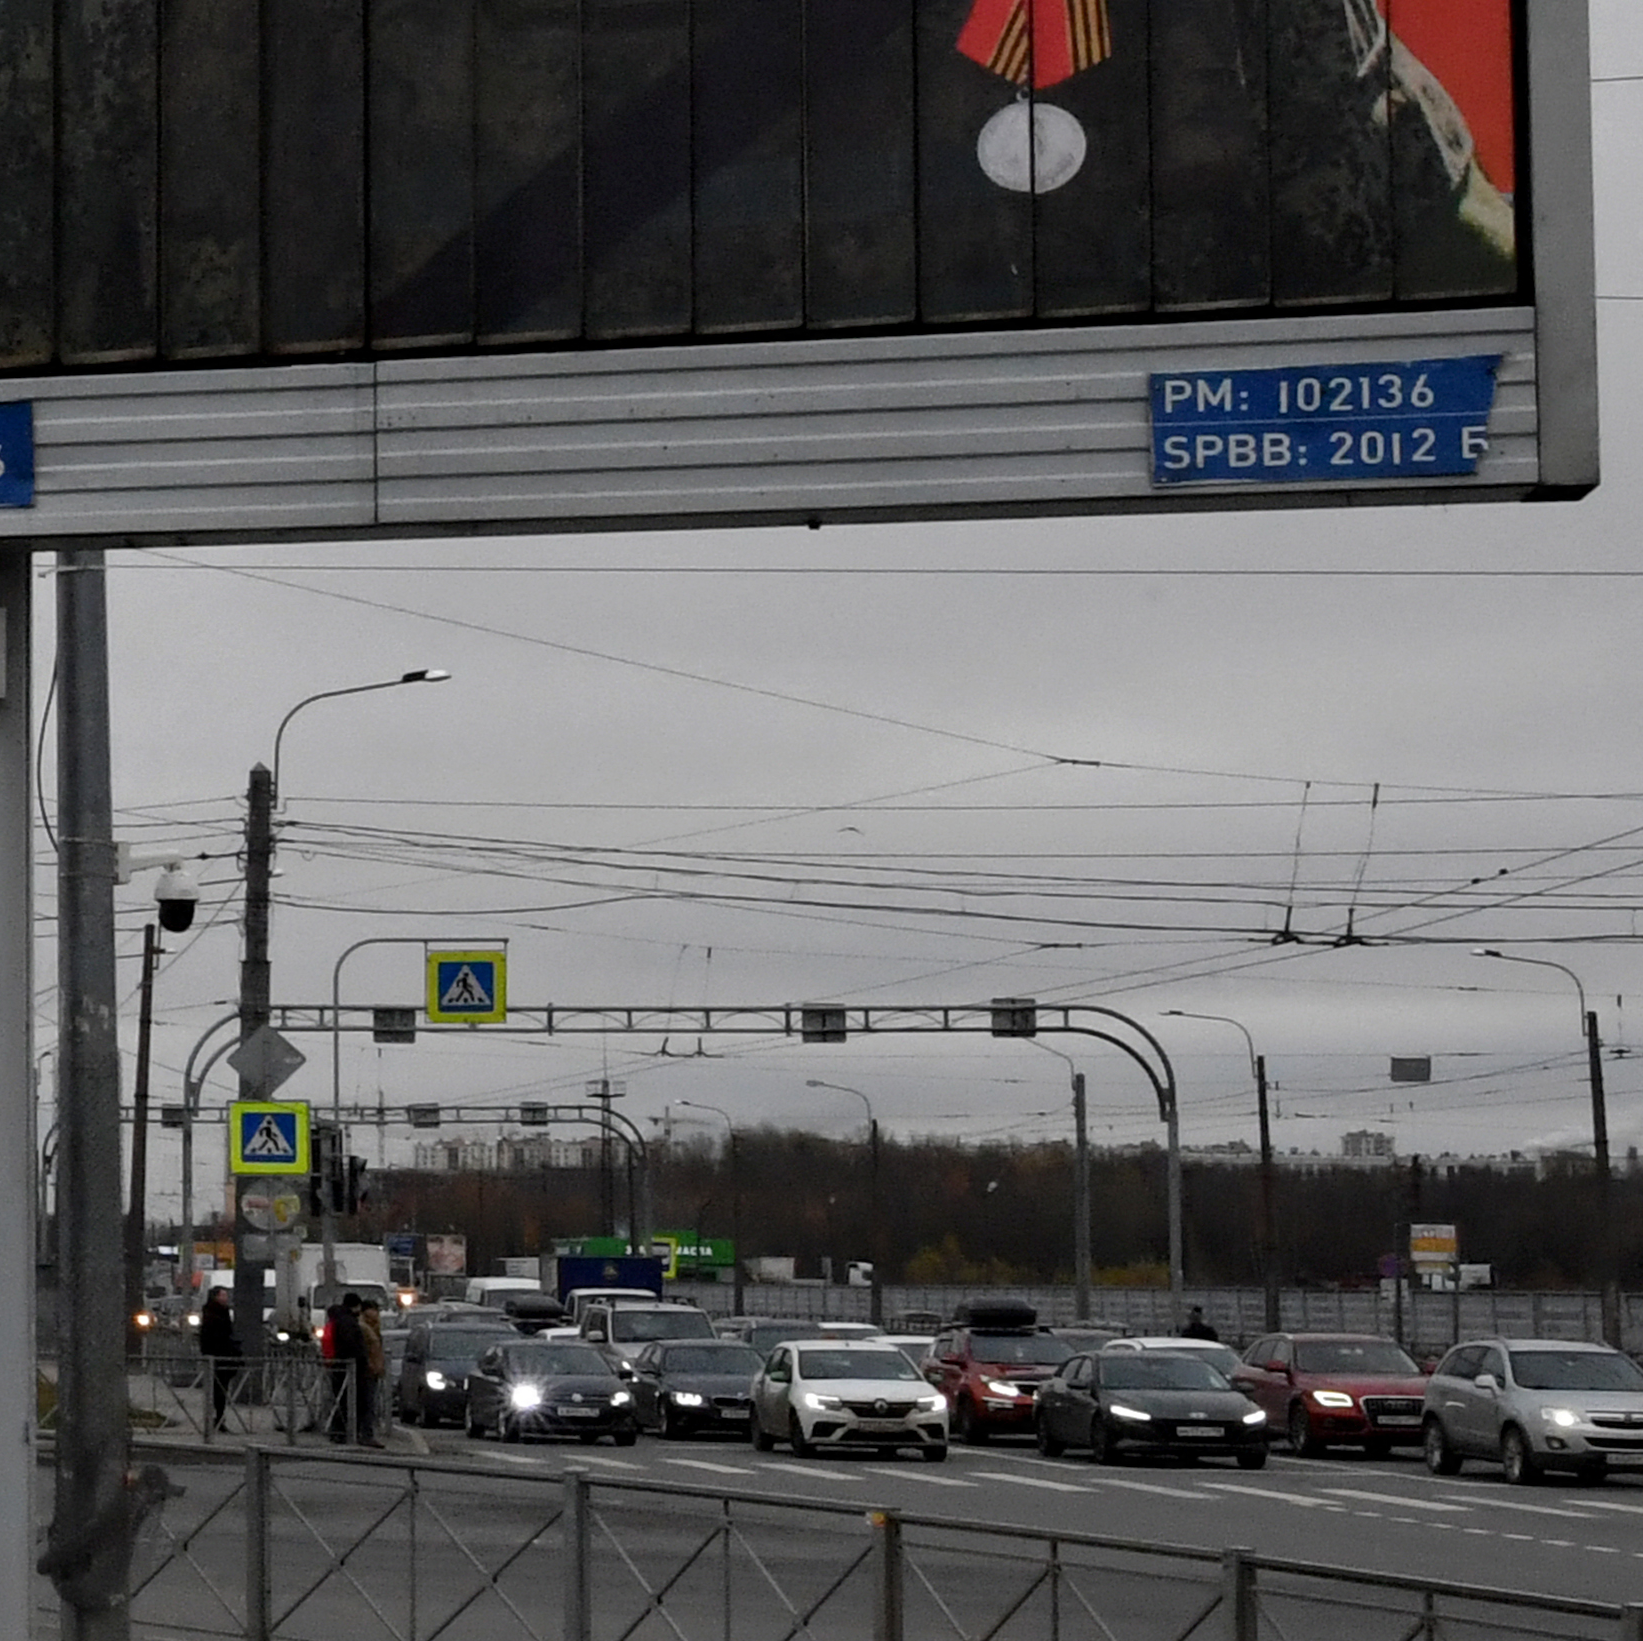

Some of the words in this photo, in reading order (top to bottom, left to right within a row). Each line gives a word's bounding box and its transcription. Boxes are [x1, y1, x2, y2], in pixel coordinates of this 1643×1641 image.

[1163, 378, 1249, 413] PM:
[1279, 373, 1435, 413] 102136
[1163, 433, 1309, 470] SPBB:
[1330, 428, 1437, 466] 2012
